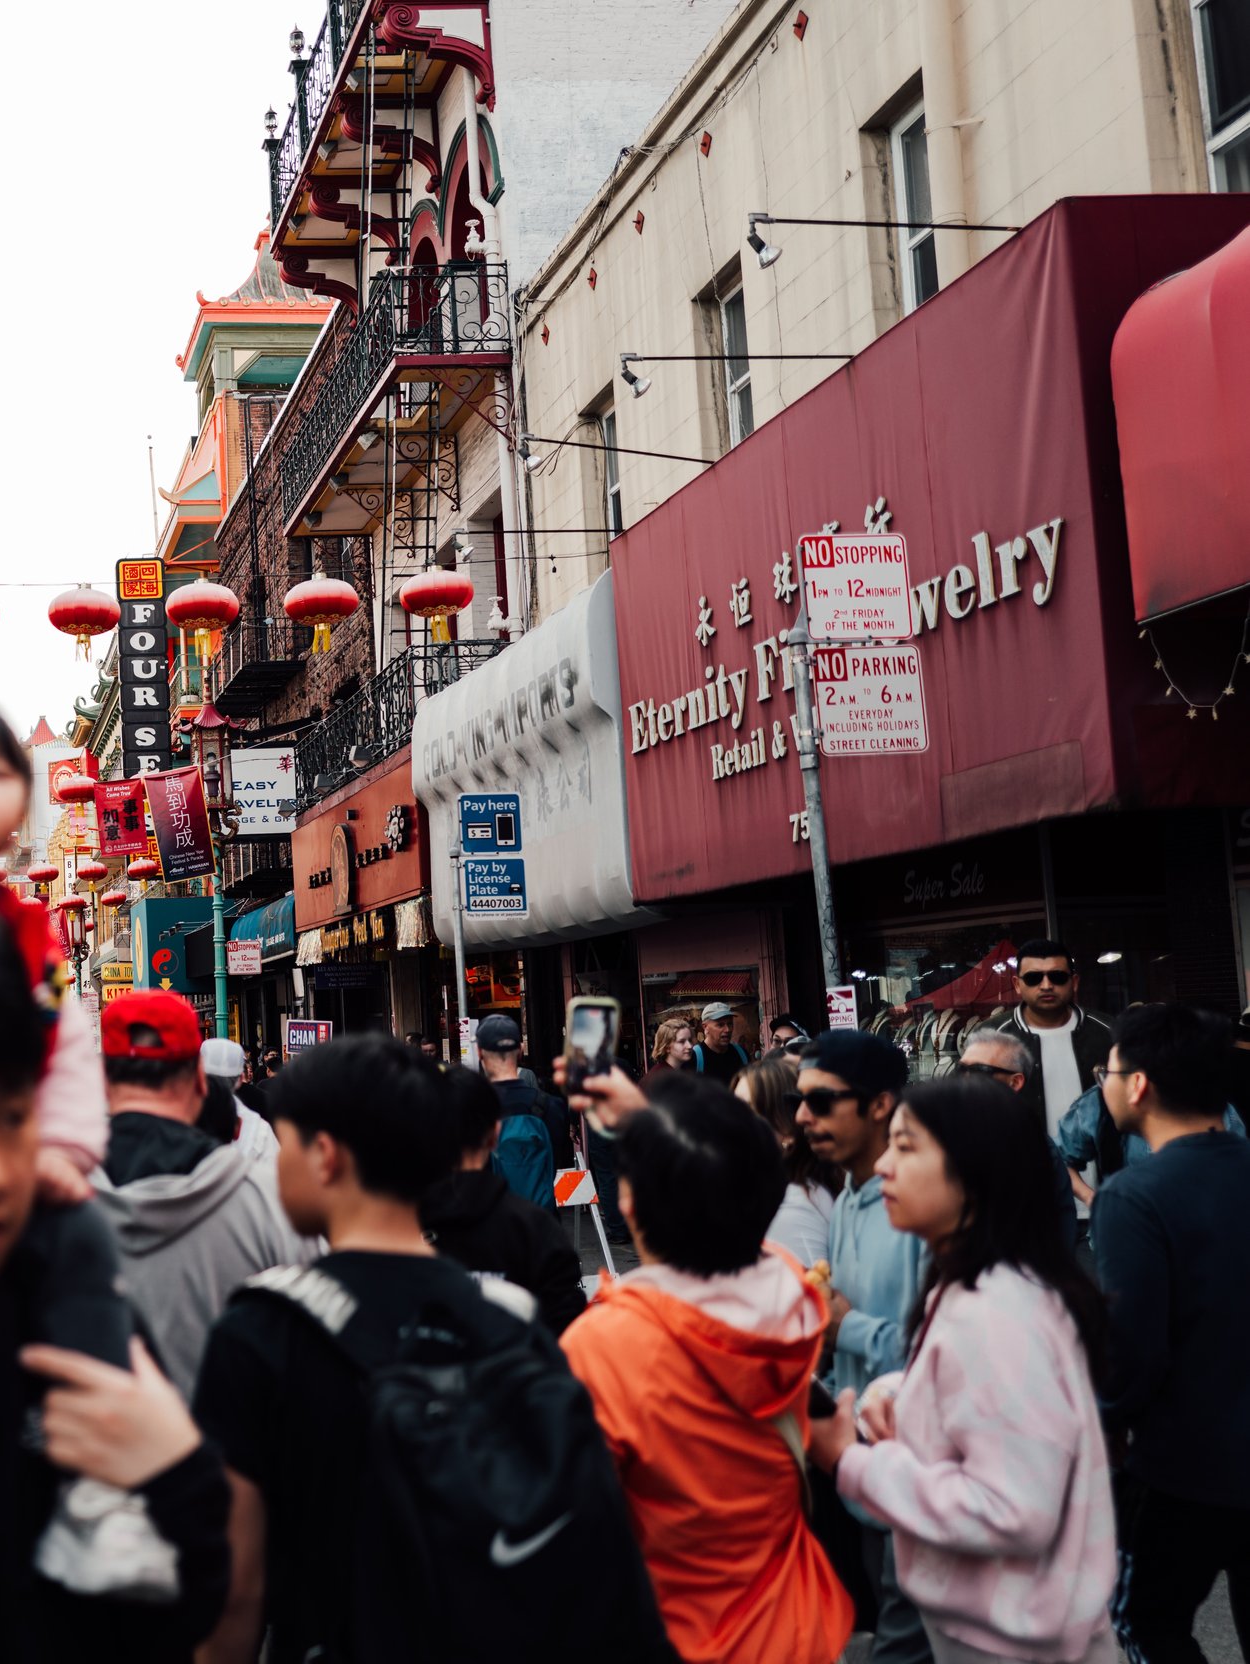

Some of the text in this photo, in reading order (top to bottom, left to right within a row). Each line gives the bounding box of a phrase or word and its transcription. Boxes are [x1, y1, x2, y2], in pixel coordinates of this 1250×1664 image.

[804, 539, 903, 566] NO STOPPING
[834, 588, 843, 596] TO
[852, 608, 885, 619] FRIDAY
[825, 620, 895, 632] OF THE MONTH
[130, 604, 160, 706] FOUR
[816, 652, 917, 680] NO PARKING
[825, 686, 837, 706] 2
[881, 684, 892, 704] 6
[628, 663, 748, 754] Eternity
[848, 709, 893, 720] EVERYDAY
[825, 719, 919, 733] INCLUDING HOLIDAYS
[710, 727, 766, 780] Retail
[771, 720, 788, 760] &
[830, 737, 919, 751] STREET CLEANING
[232, 781, 277, 791] EASY
[165, 774, 195, 849] 馬到功成
[463, 799, 517, 814] Pay here
[468, 862, 507, 875] Pay by
[468, 873, 511, 884] License
[469, 885, 499, 895] Plate
[903, 862, 985, 910] Super Sale
[471, 898, 522, 908] 44407003
[228, 942, 260, 951] NO STOPPING
[104, 966, 121, 978] CHINA
[289, 1030, 316, 1046] CHAN
